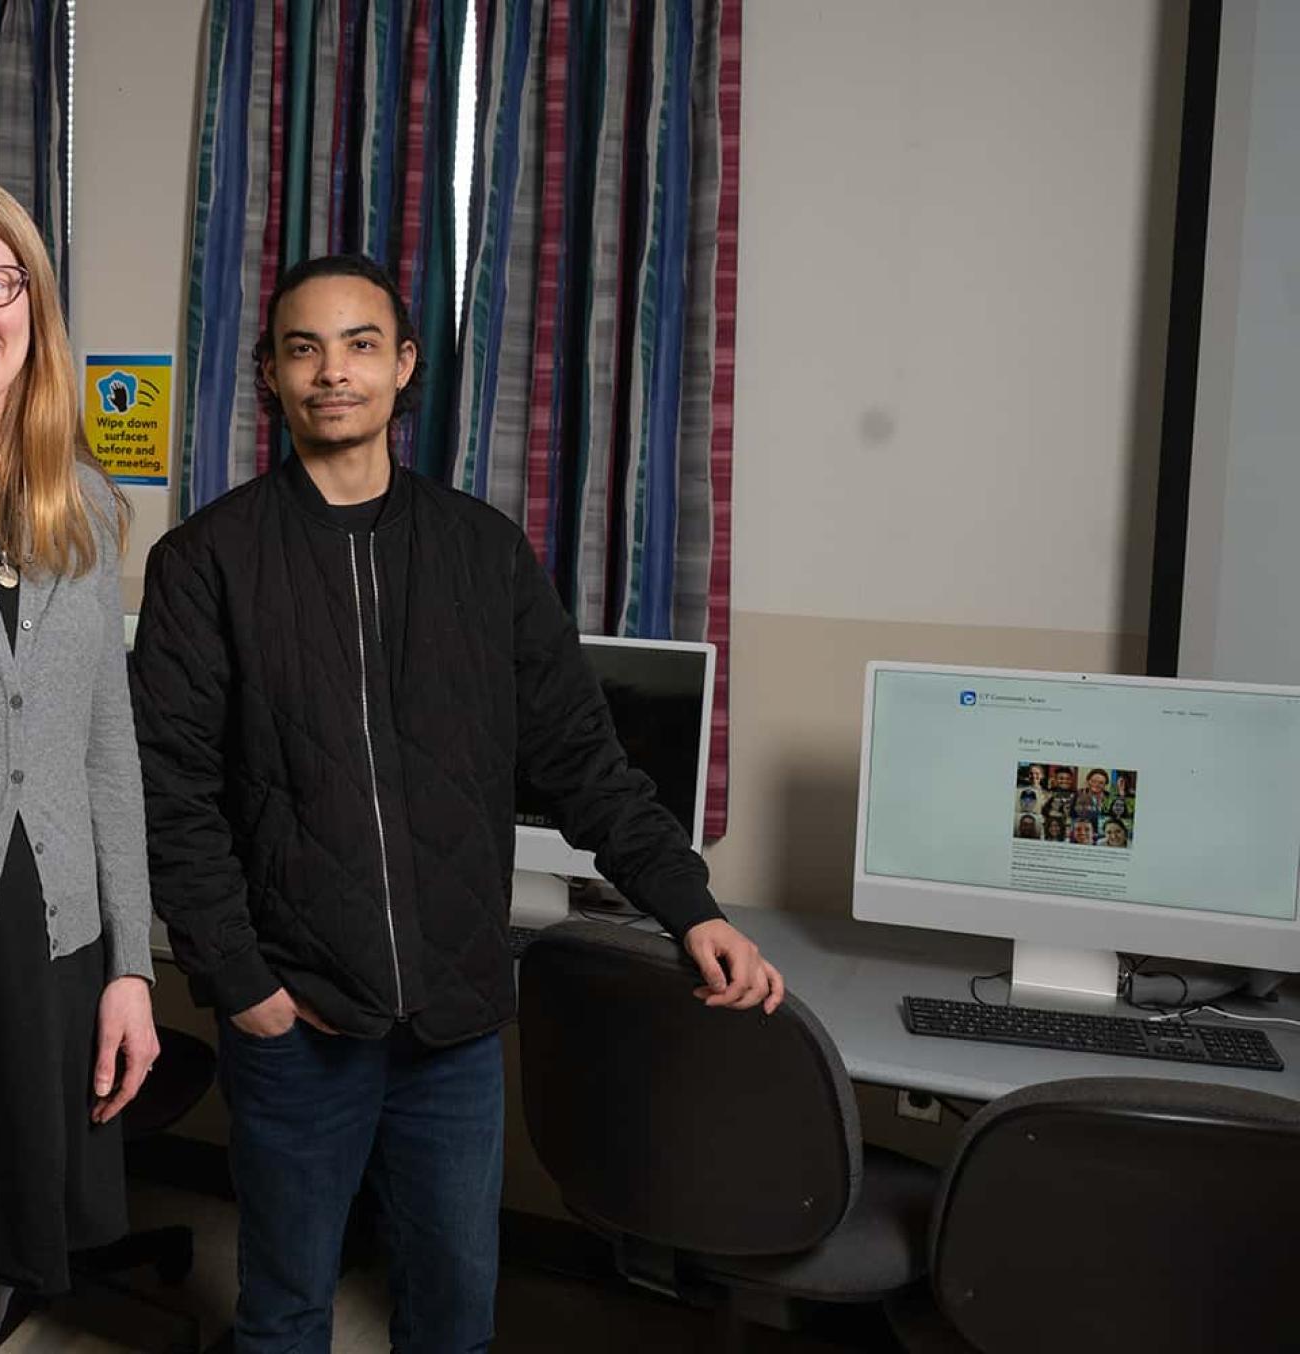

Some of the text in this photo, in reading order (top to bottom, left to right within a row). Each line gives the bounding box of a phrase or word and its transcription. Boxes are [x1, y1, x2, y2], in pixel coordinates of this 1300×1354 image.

[97, 417, 158, 429] Wipe down
[104, 430, 149, 442] surfaces
[97, 444, 156, 456] before and
[116, 458, 164, 471] meeting.
